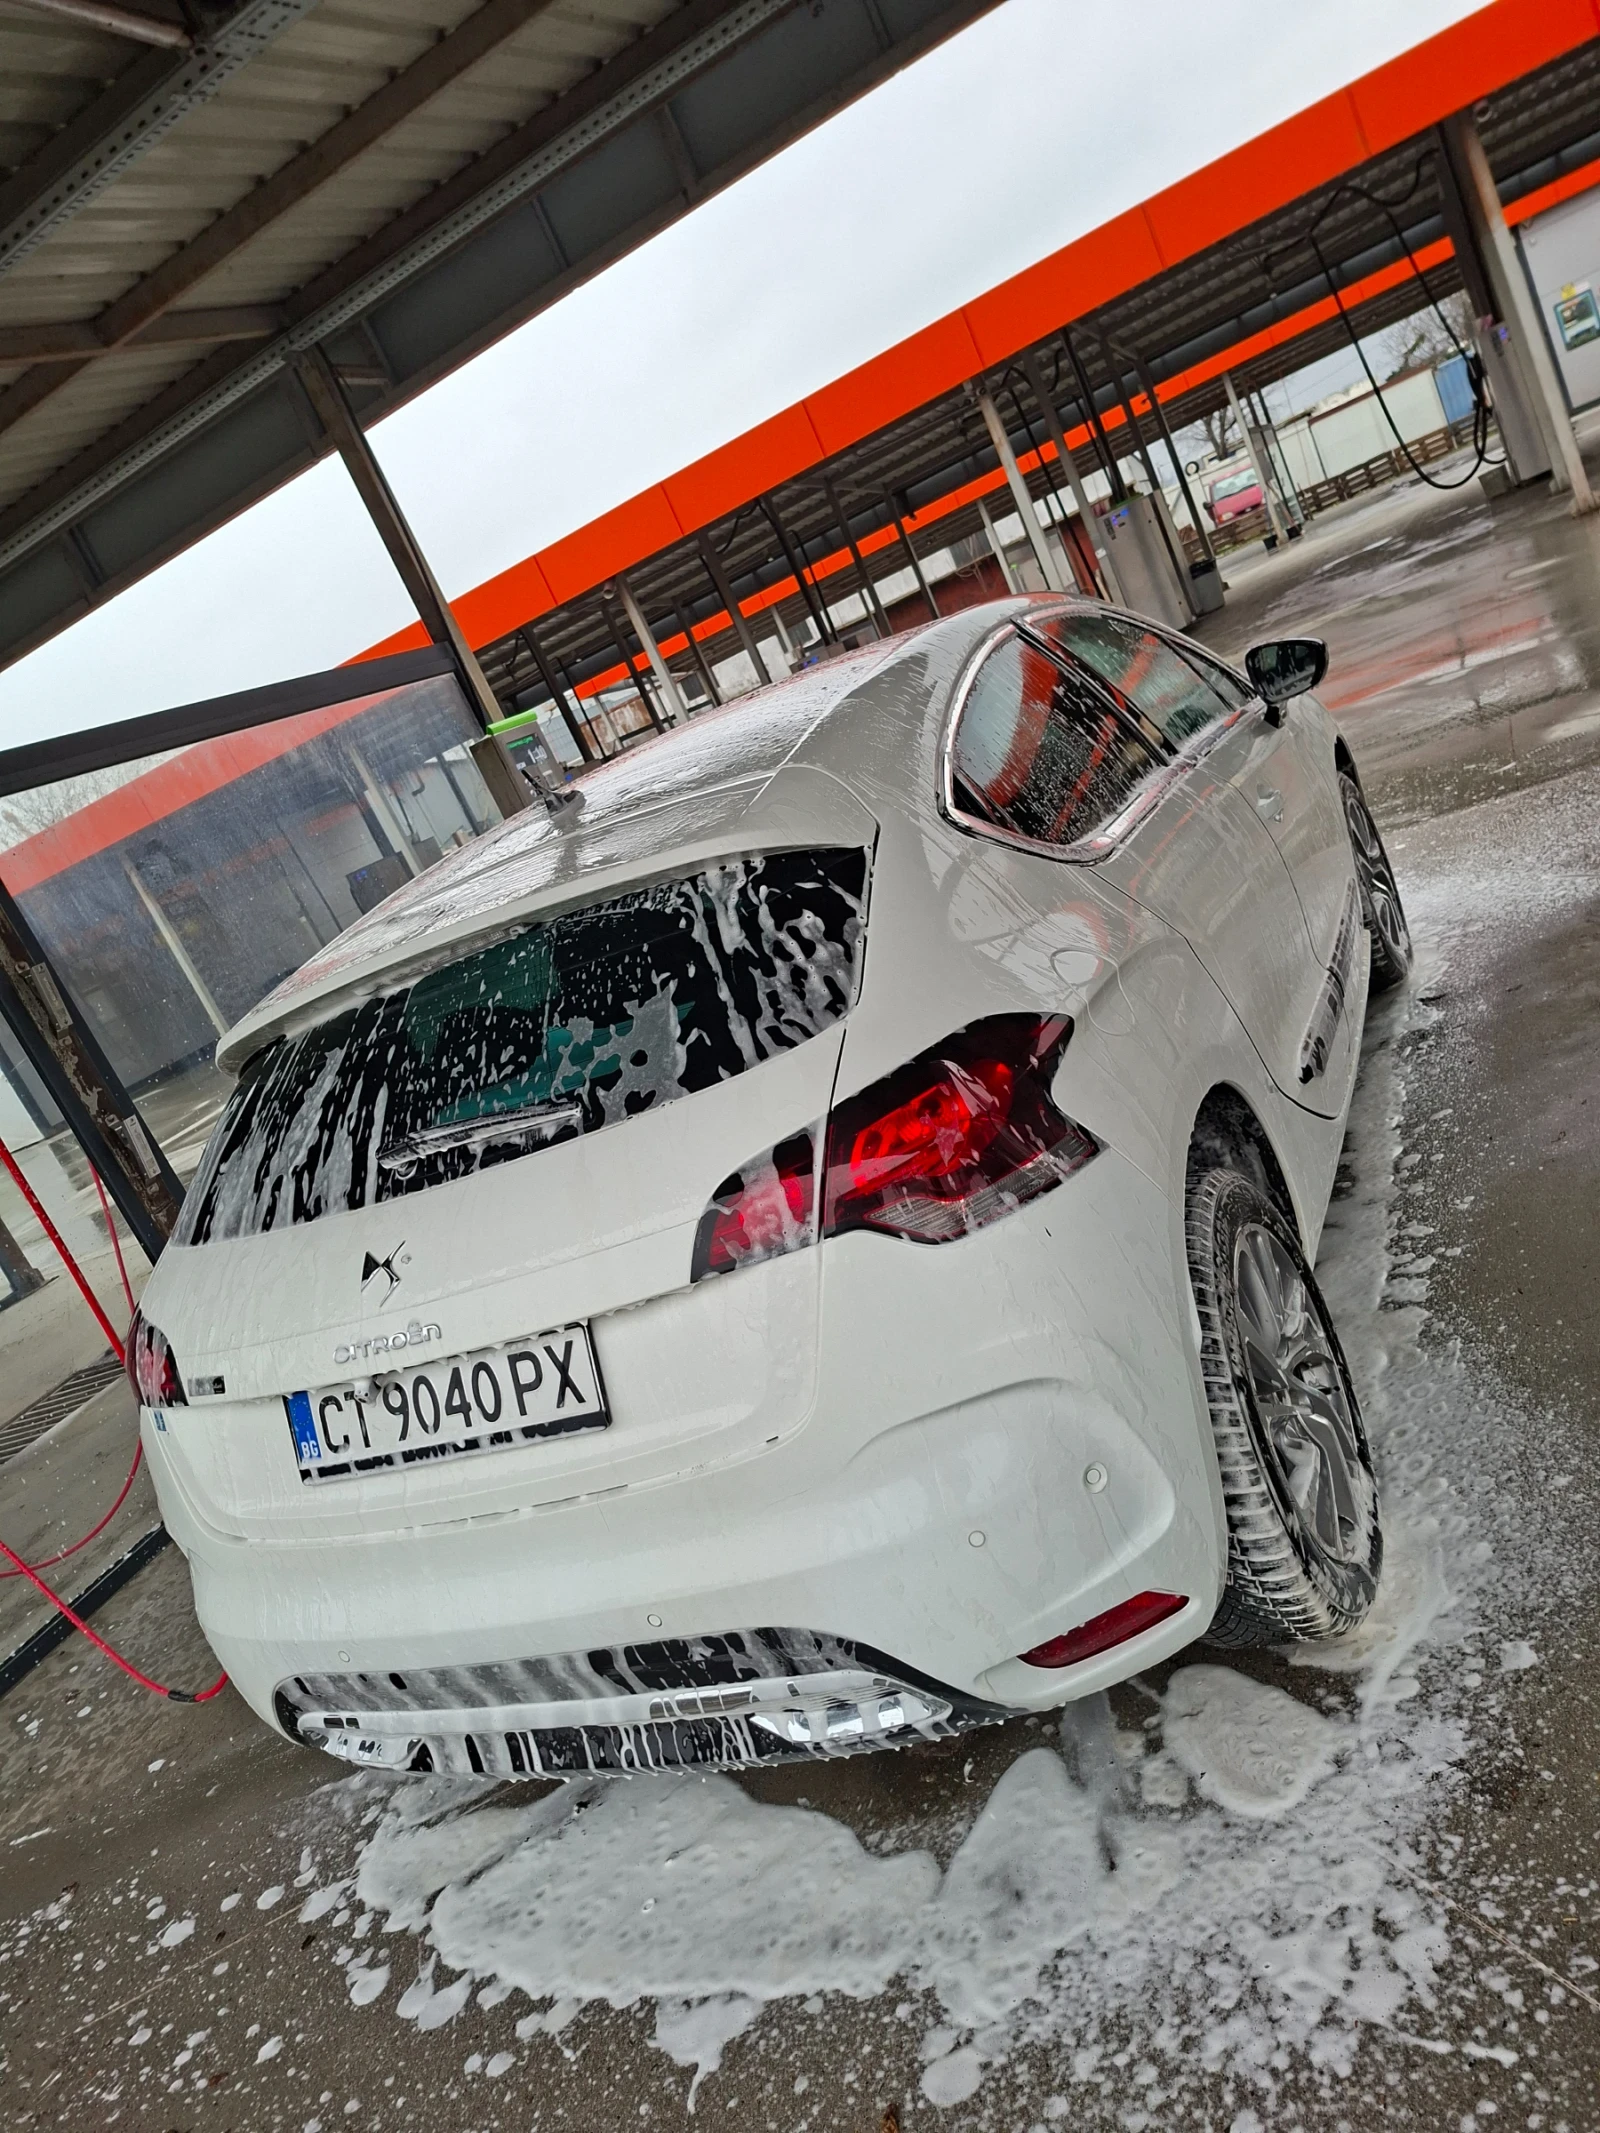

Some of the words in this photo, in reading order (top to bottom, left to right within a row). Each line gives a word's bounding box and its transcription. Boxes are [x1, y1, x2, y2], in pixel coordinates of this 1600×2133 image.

[319, 1390, 371, 1454] CT
[382, 1361, 501, 1442] 9040
[507, 1340, 587, 1417] PX
[301, 1439, 319, 1459] BG
